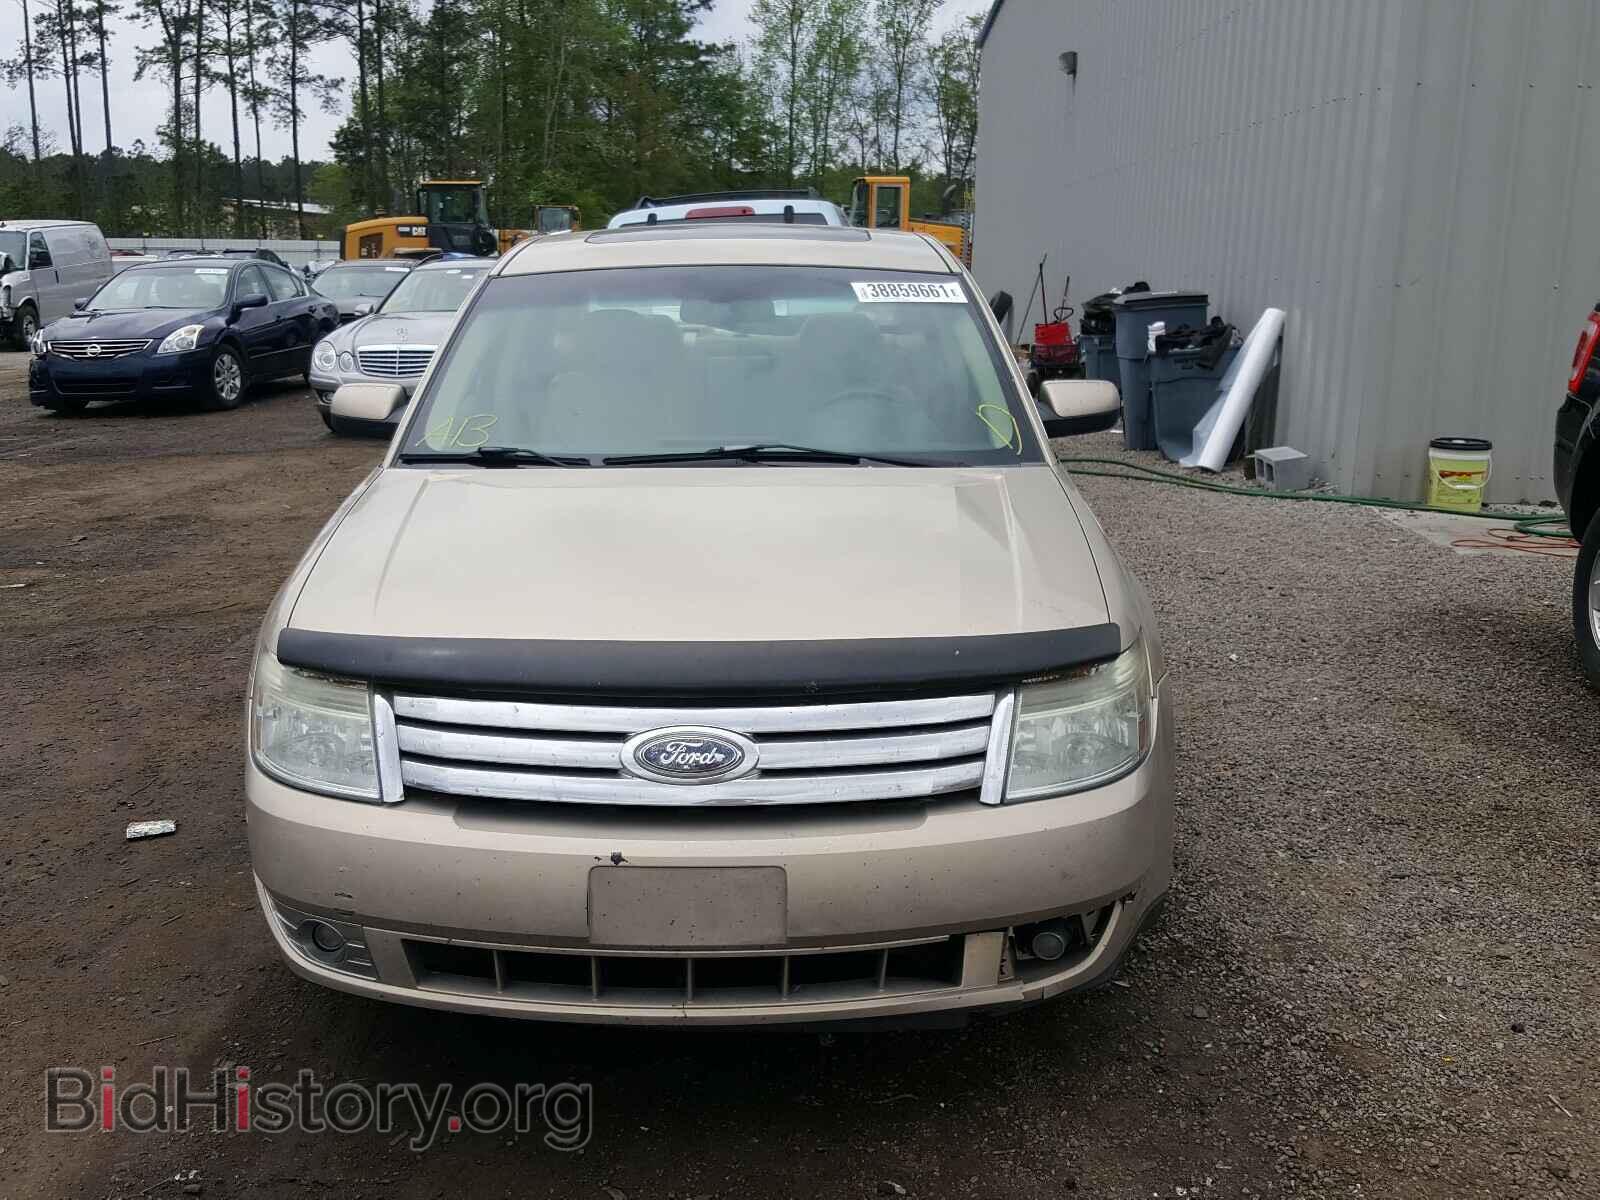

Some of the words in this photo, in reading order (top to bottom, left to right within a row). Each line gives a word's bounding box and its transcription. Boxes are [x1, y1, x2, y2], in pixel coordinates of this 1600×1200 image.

[412, 226, 427, 236] CAT
[866, 283, 950, 299] 38859661
[659, 741, 725, 765] Ford
